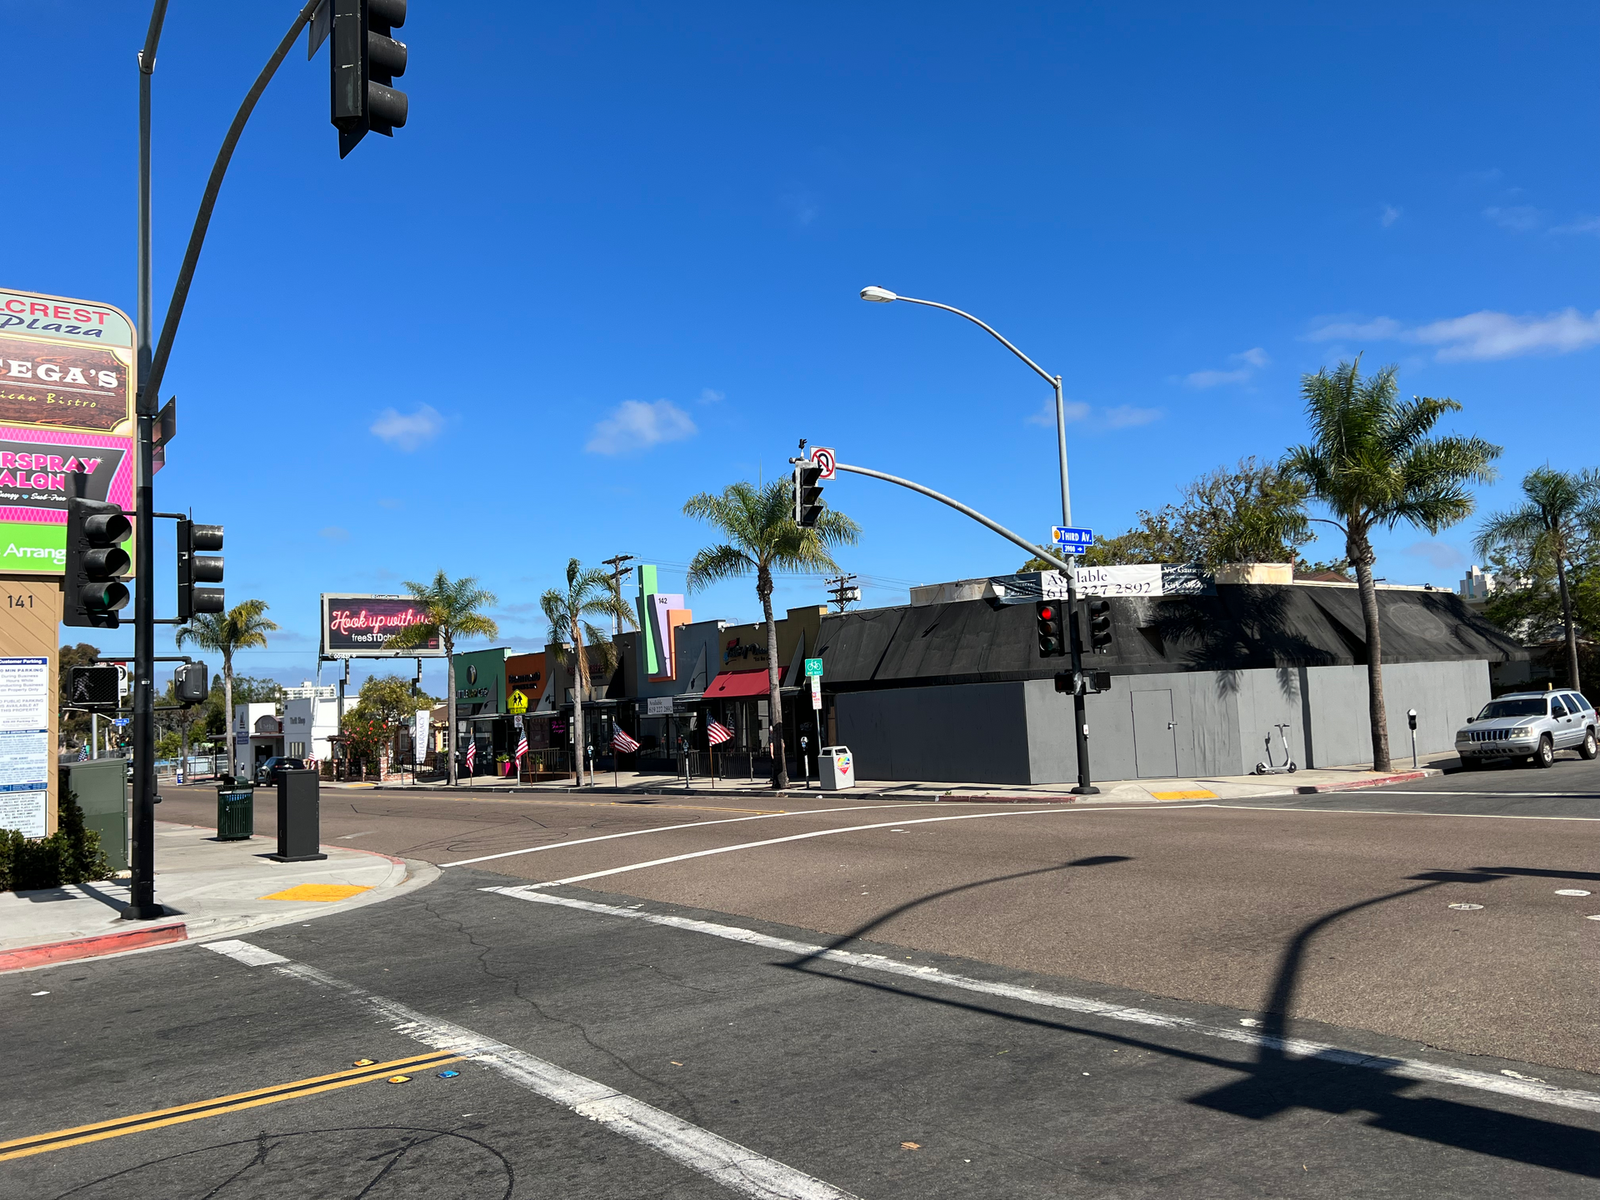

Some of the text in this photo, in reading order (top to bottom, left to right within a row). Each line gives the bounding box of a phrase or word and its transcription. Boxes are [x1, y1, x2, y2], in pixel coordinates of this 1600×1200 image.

[0, 313, 103, 338] Plaza
[46, 392, 97, 408] Bistro
[1047, 569, 1108, 586] Avlable
[1046, 587, 1064, 599] 61
[1081, 584, 1108, 596] 227
[1115, 582, 1152, 595] 2892
[7, 594, 34, 608] 141
[330, 610, 368, 635] Hook
[369, 616, 386, 634] up
[387, 608, 416, 627] with
